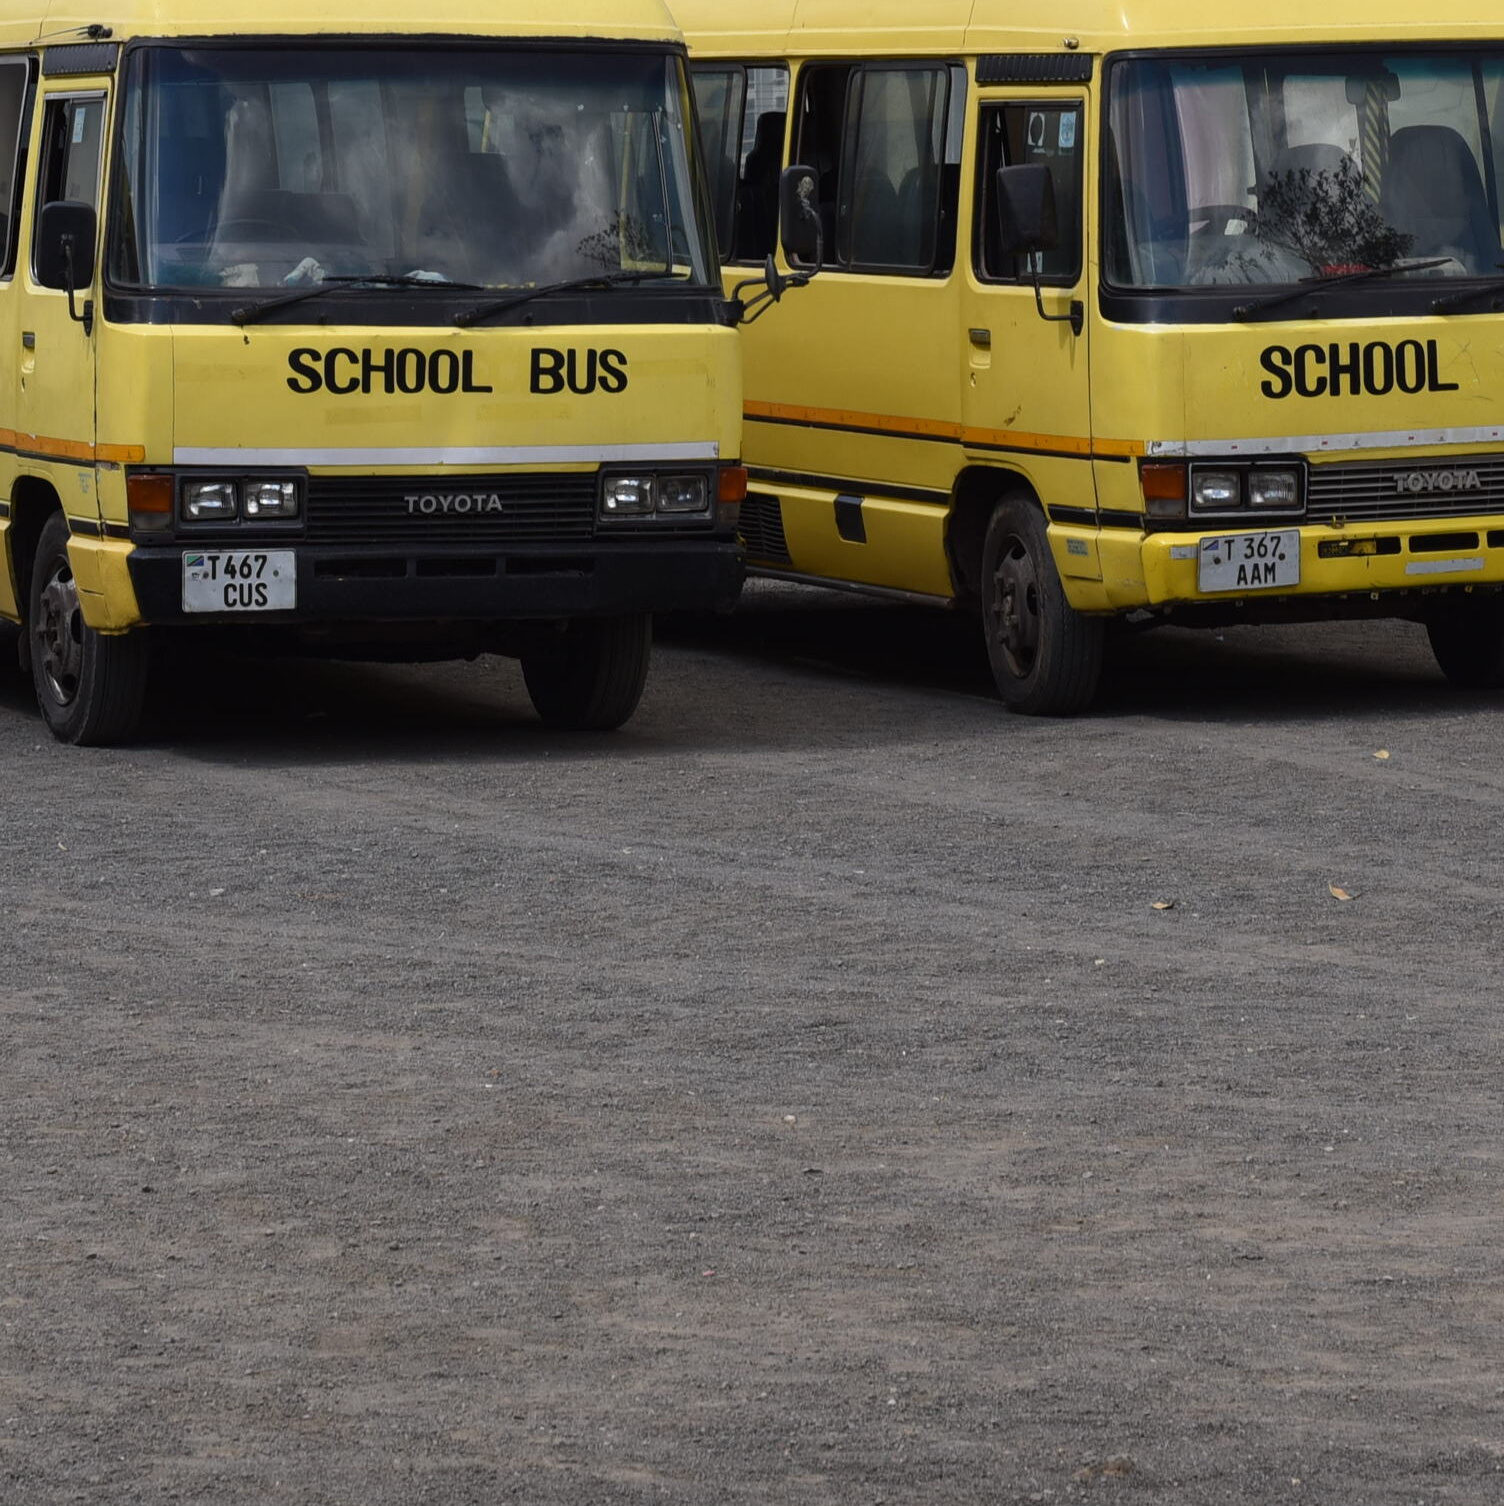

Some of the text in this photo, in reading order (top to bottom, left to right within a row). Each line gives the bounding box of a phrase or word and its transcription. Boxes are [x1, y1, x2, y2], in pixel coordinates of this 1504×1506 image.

[287, 347, 628, 395] SCHOOL BUS
[1259, 339, 1459, 399] SCHOOL
[1393, 470, 1482, 492] TOYOTA
[404, 494, 503, 514] TOYOTA
[1245, 535, 1282, 560] 367
[1237, 562, 1276, 586] AAM
[223, 582, 268, 608] CUS
